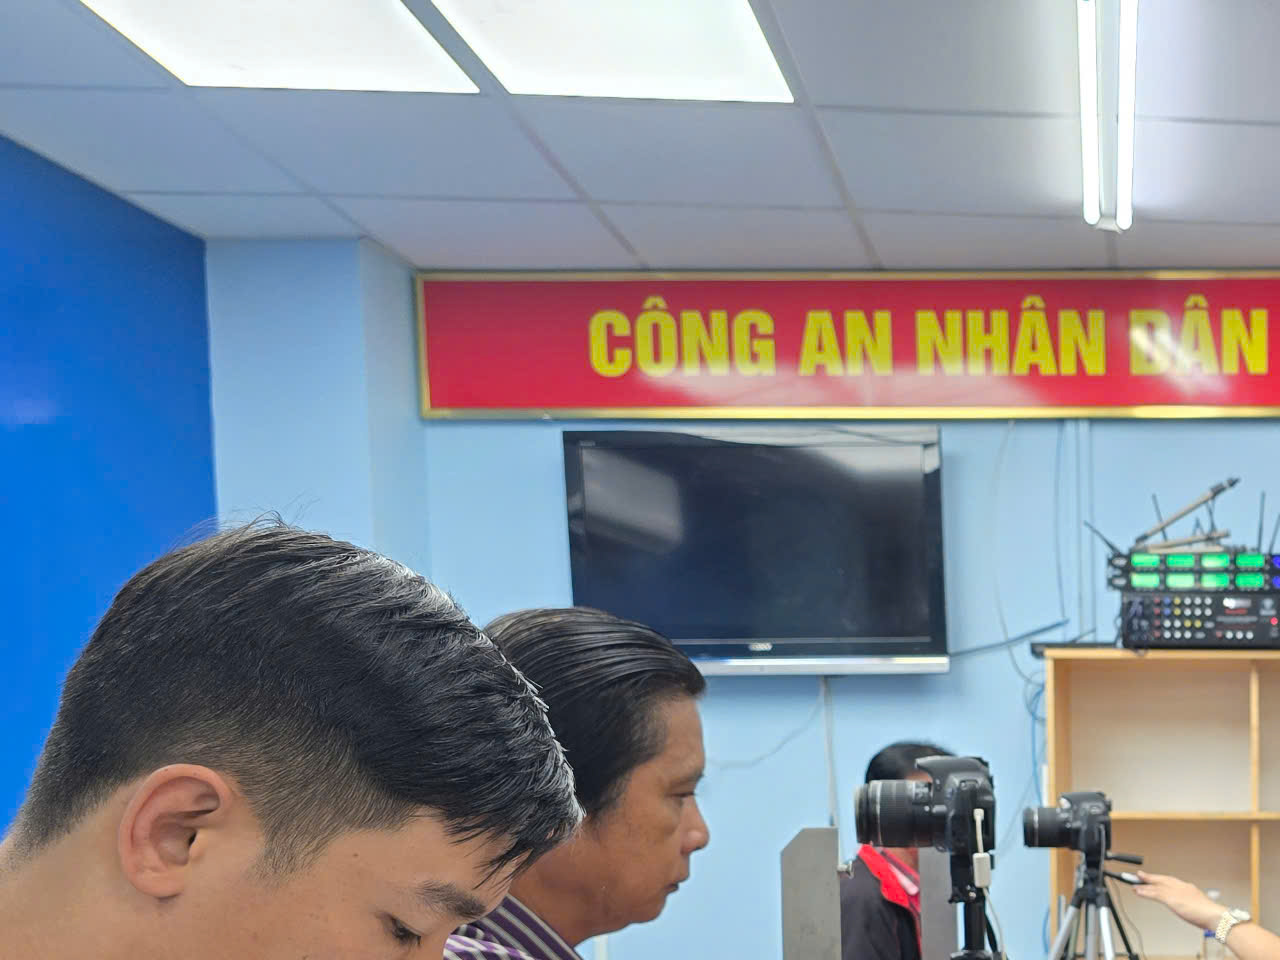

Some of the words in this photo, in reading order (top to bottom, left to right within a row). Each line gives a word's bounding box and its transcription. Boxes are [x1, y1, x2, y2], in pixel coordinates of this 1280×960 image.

[588, 296, 775, 377] CÔNG
[799, 309, 892, 377] AN
[915, 295, 1106, 376] NHÂN
[1128, 294, 1269, 376] DÂN
